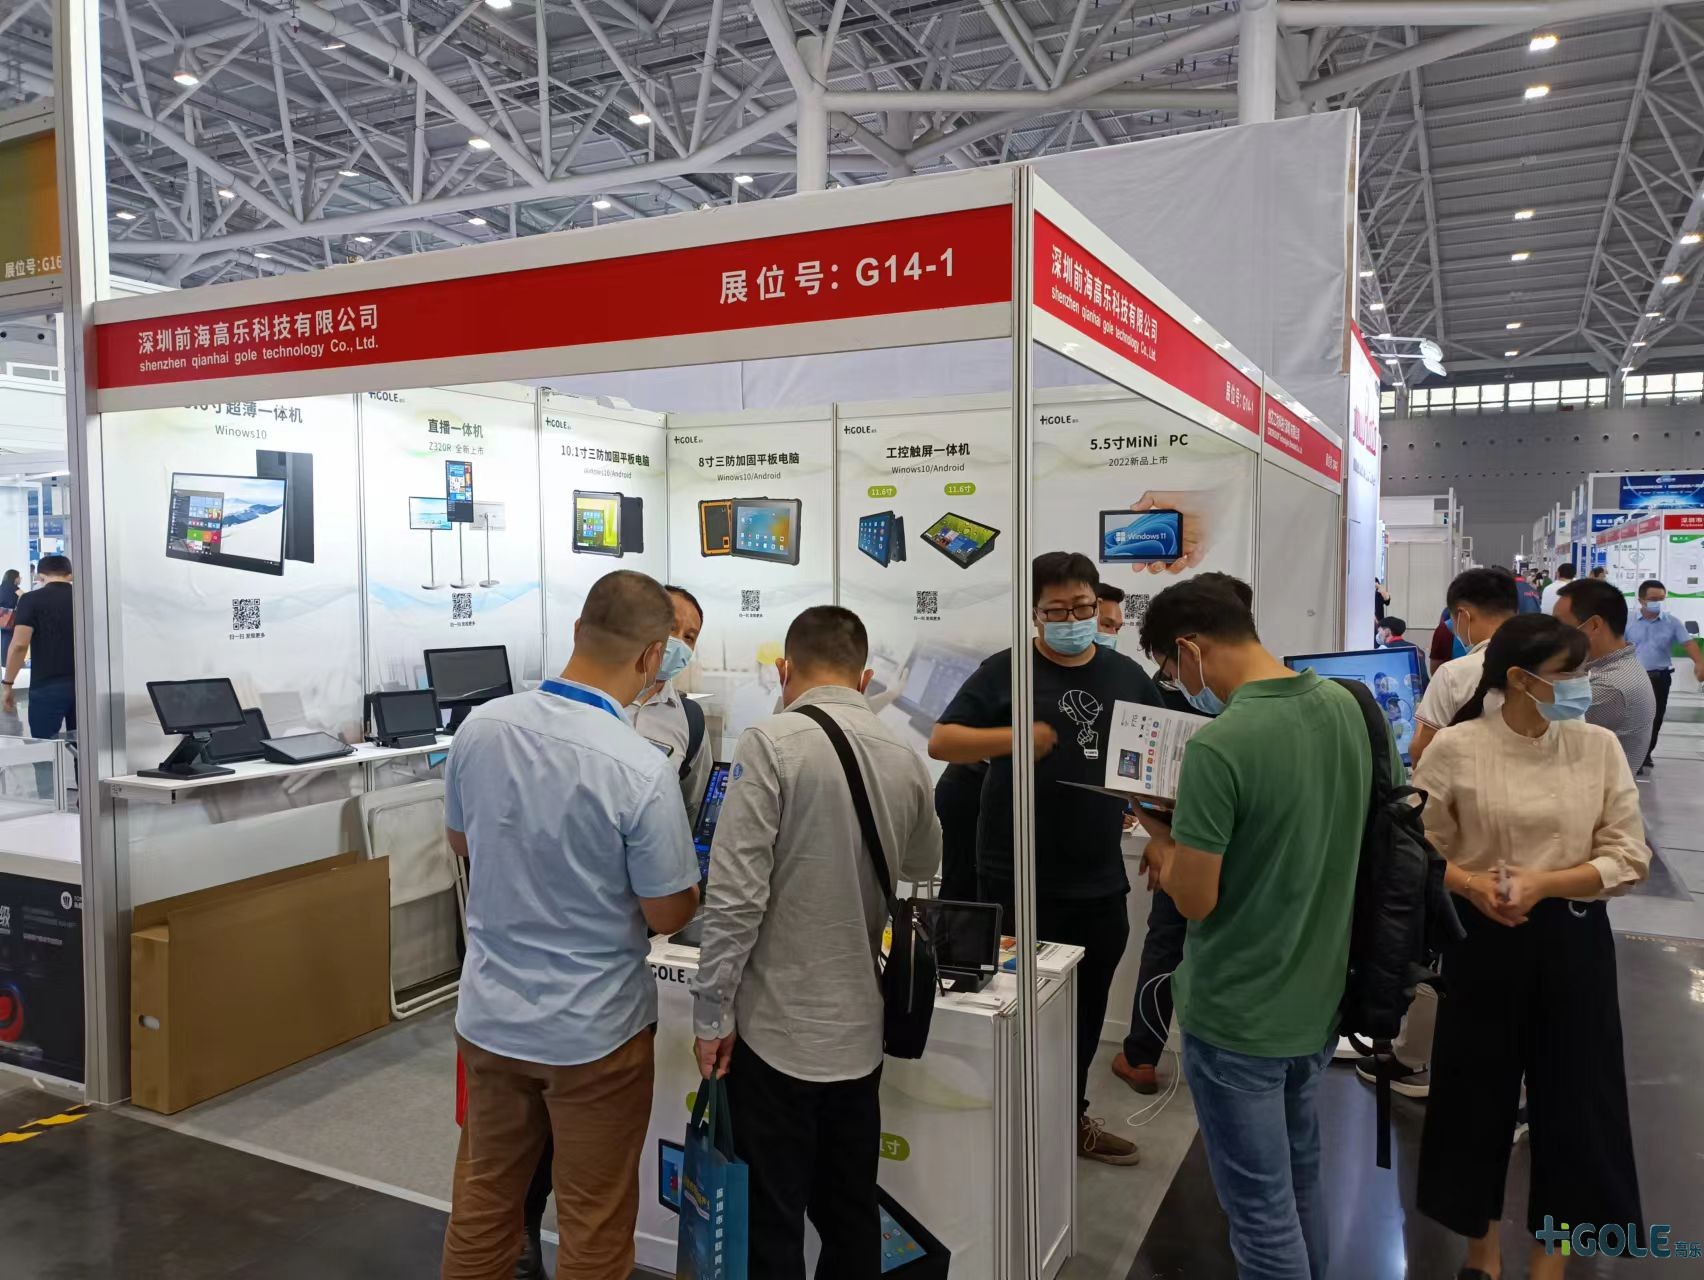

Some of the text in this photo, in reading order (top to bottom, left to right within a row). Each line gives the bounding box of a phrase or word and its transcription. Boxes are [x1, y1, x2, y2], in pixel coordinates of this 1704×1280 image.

[1051, 244, 1158, 344] 深圳前海高乐科技有限公司
[1051, 285, 1080, 315] shenzhen
[138, 304, 378, 354] 深圳前海高乐科技有限公司
[140, 357, 187, 372] shenzhen
[191, 351, 229, 369] qianhai
[234, 348, 257, 365] gole
[262, 343, 325, 360] technology
[428, 418, 484, 438] 直播一体机
[1169, 433, 1189, 446] PC
[561, 444, 650, 467] 10.1寸三防加固平板电脑
[886, 442, 971, 459] 工控触屏一体机
[698, 452, 800, 468] 8寸三防加固平板电脑
[891, 463, 965, 475] Winows10/Android
[1108, 456, 1168, 467] 2022新品上市
[1127, 532, 1160, 541] Windows
